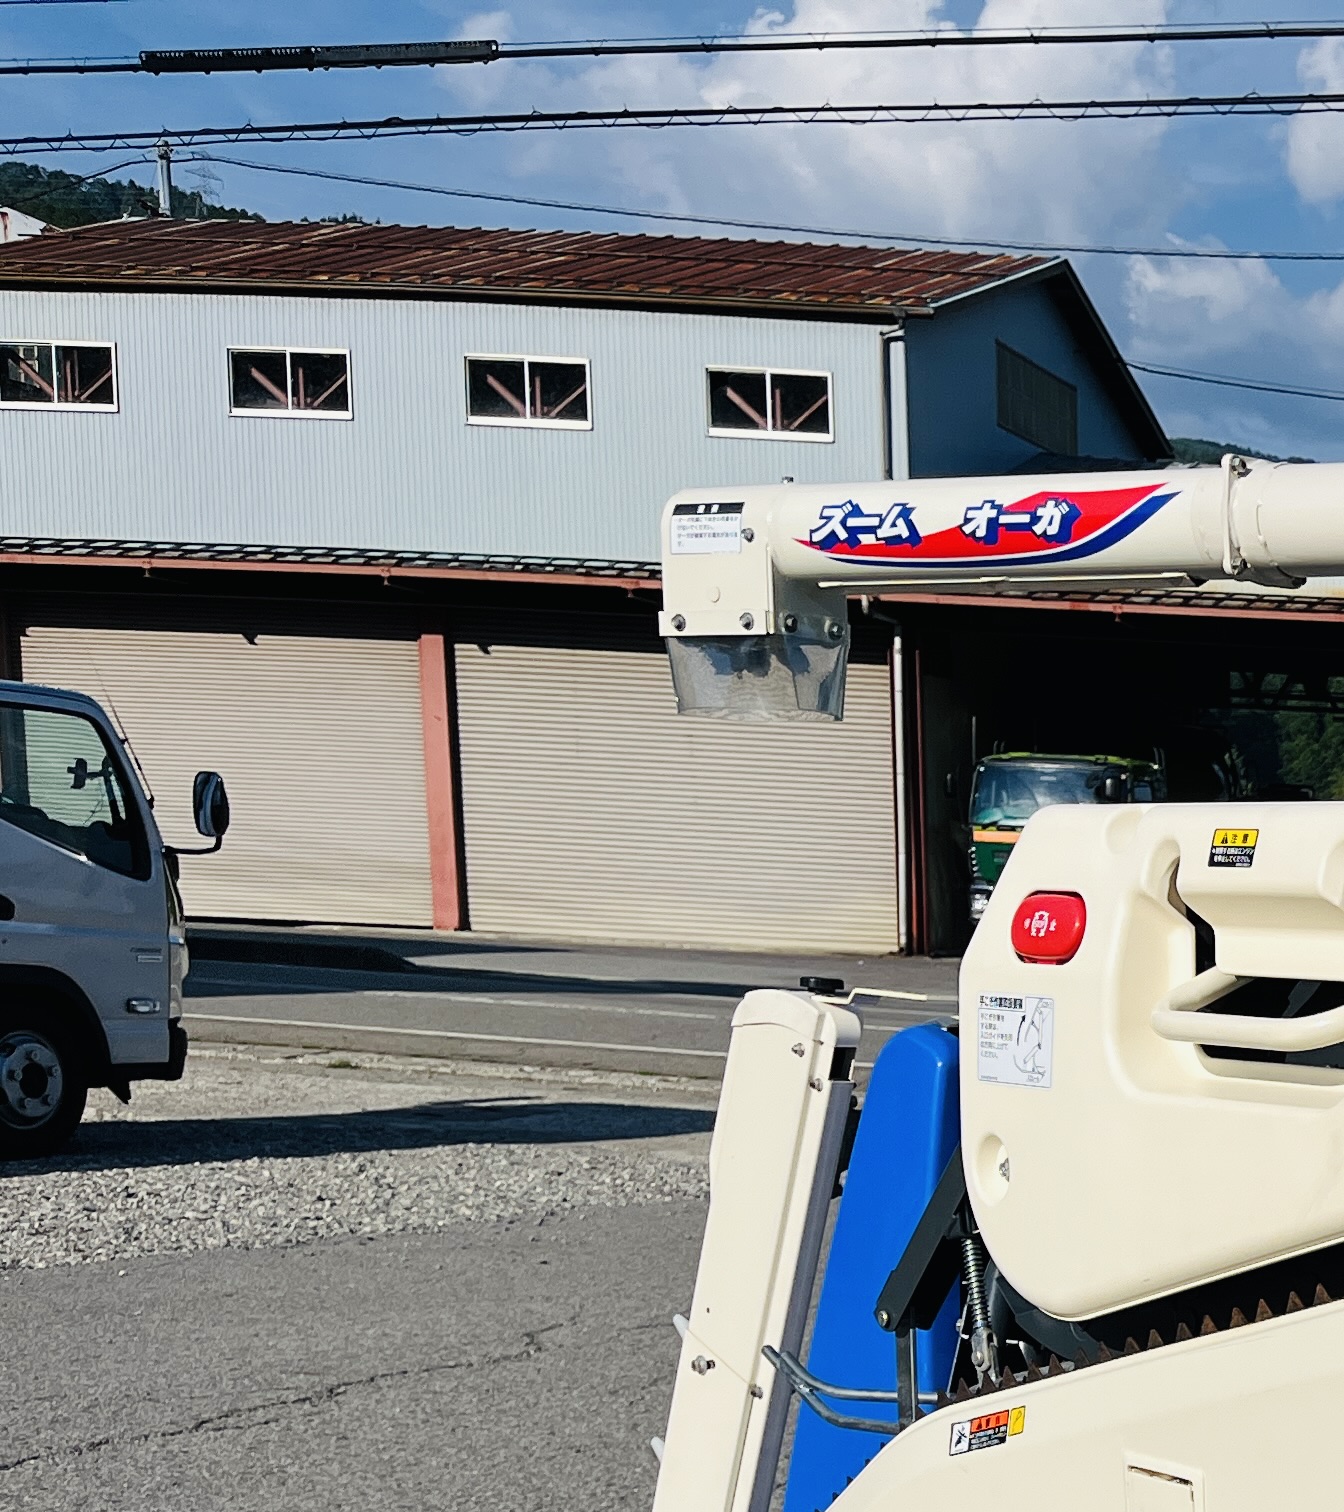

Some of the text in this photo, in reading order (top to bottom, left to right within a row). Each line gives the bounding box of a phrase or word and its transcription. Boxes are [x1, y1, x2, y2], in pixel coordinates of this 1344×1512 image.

[810, 498, 1082, 550] ズーム オーガ
